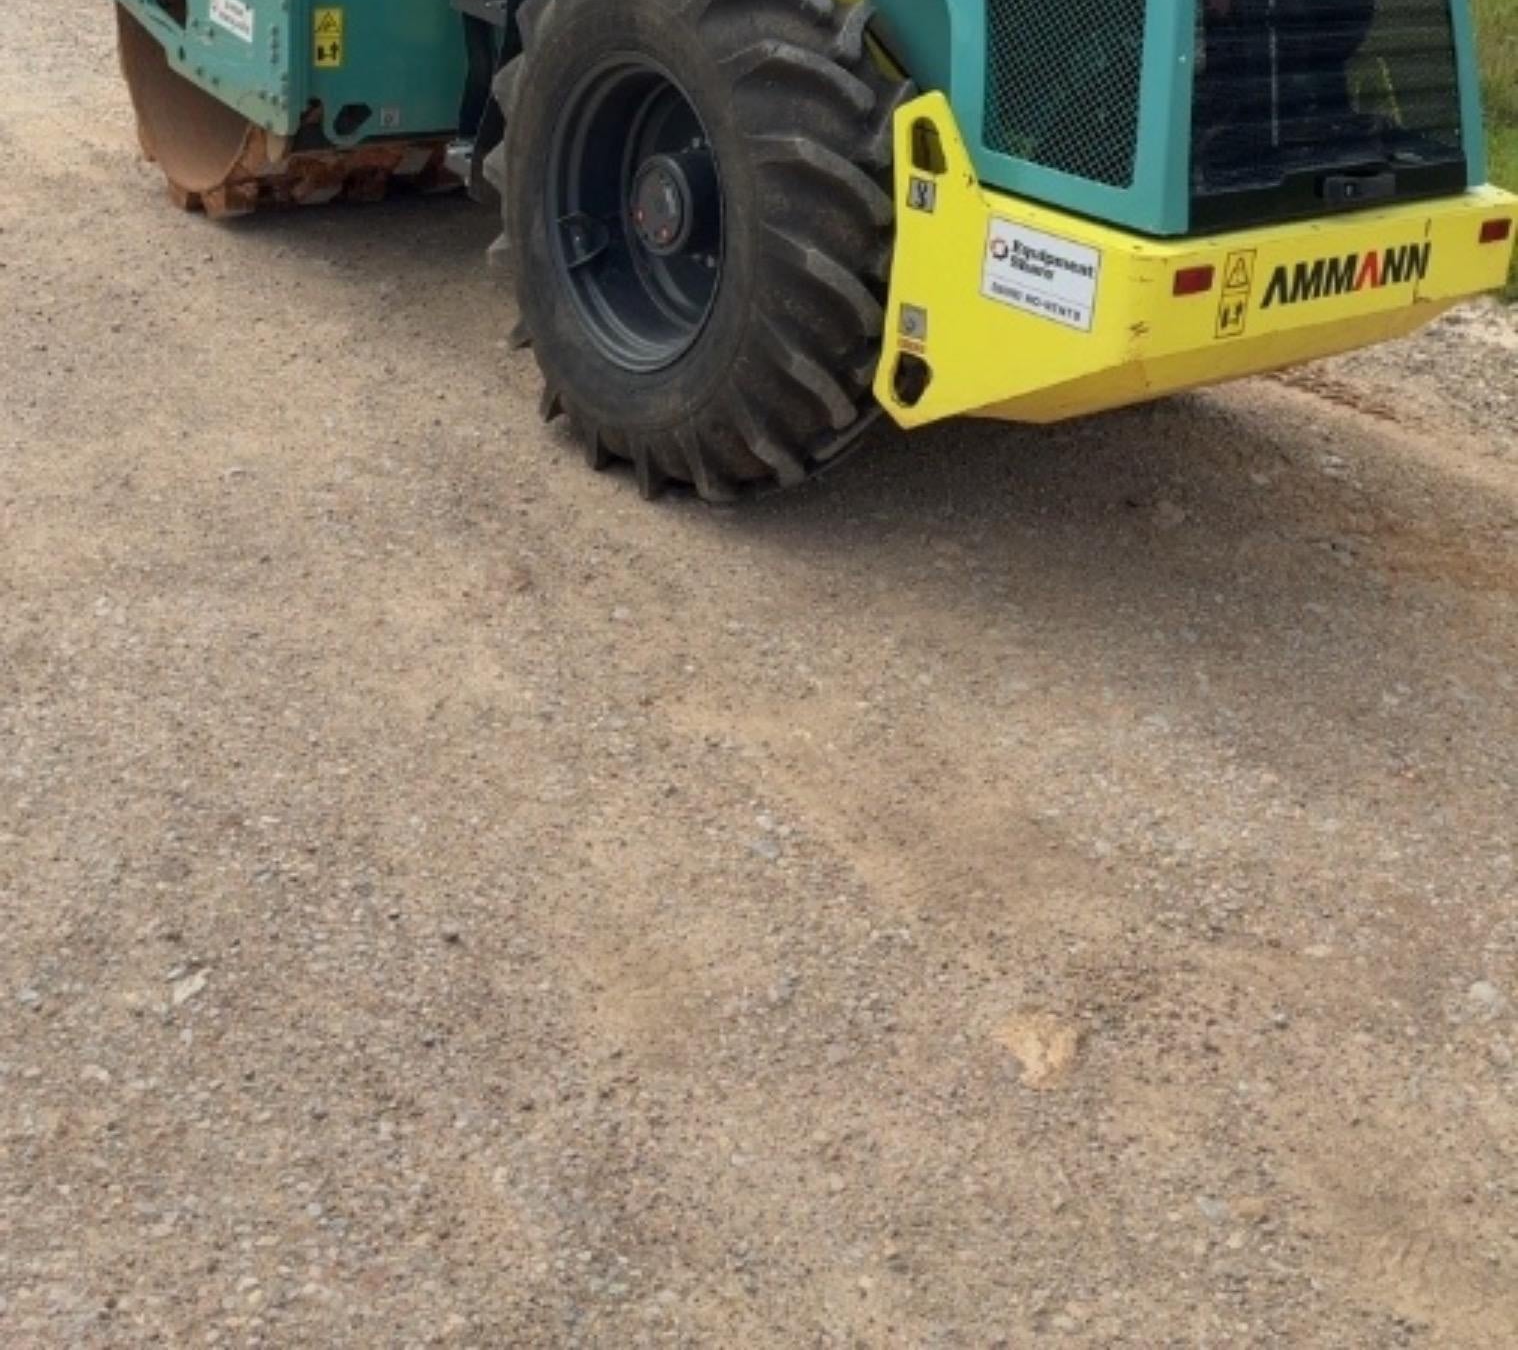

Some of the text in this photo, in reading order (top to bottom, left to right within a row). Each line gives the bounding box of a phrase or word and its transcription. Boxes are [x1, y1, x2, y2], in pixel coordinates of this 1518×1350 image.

[1010, 254, 1054, 280] Share
[1012, 239, 1093, 279] Equipment
[1259, 241, 1432, 309] AMMANN
